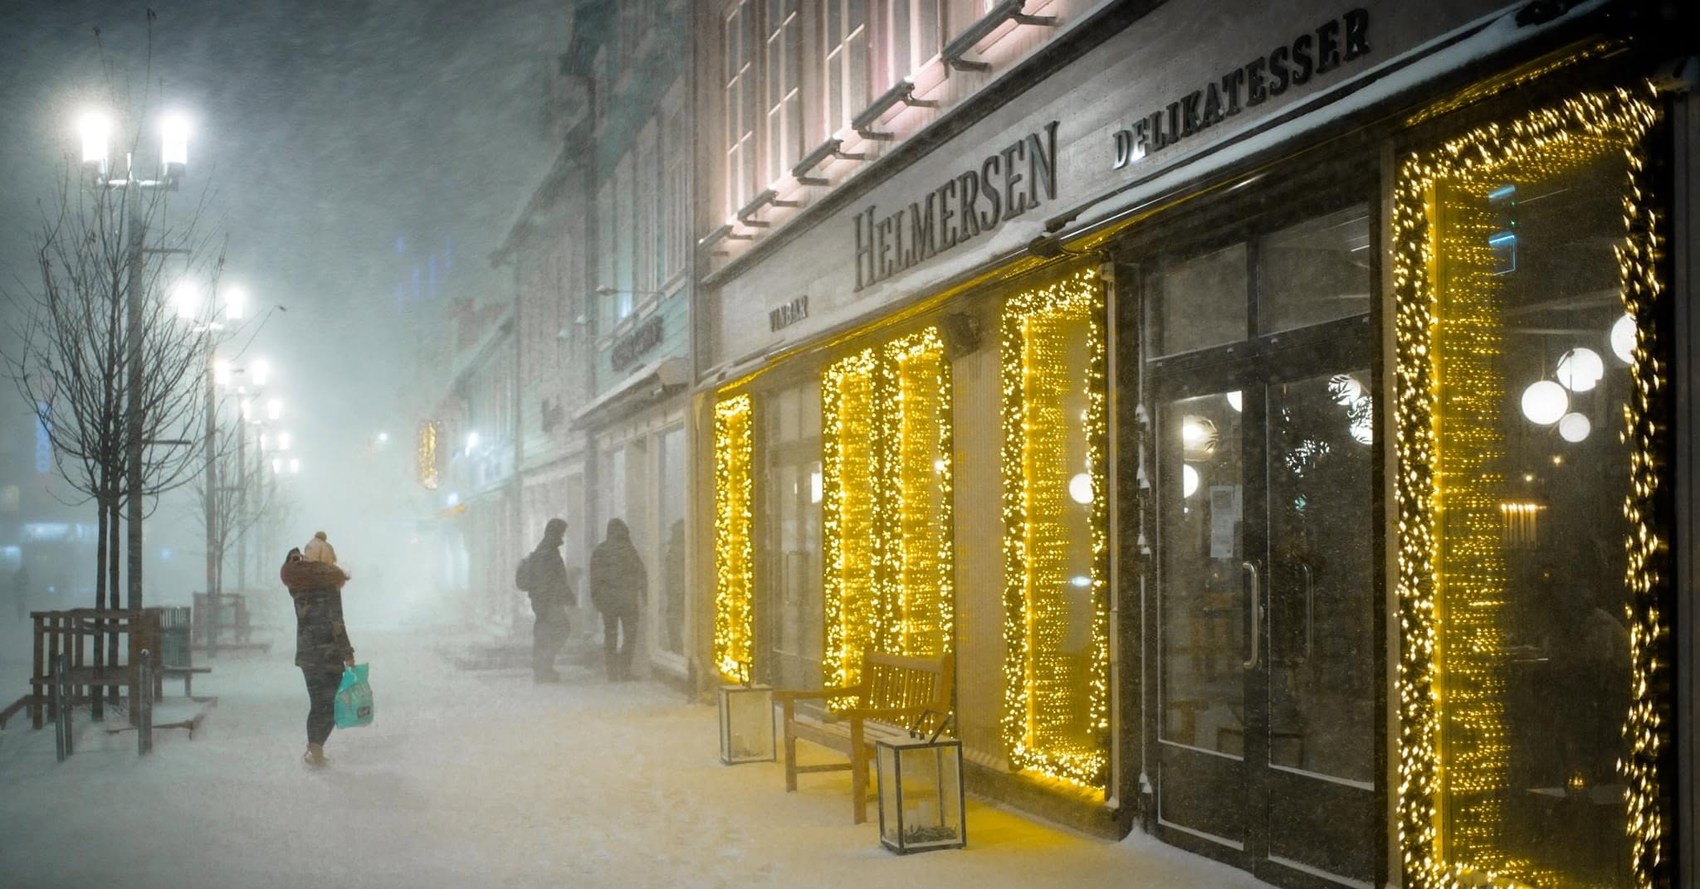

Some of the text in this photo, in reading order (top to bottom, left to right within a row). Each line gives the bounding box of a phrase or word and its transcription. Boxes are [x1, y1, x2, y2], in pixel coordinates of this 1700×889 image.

[1113, 8, 1370, 169] DELIKATESSER
[852, 121, 1060, 292] HELMERSEN
[769, 295, 808, 332] VINBAR
